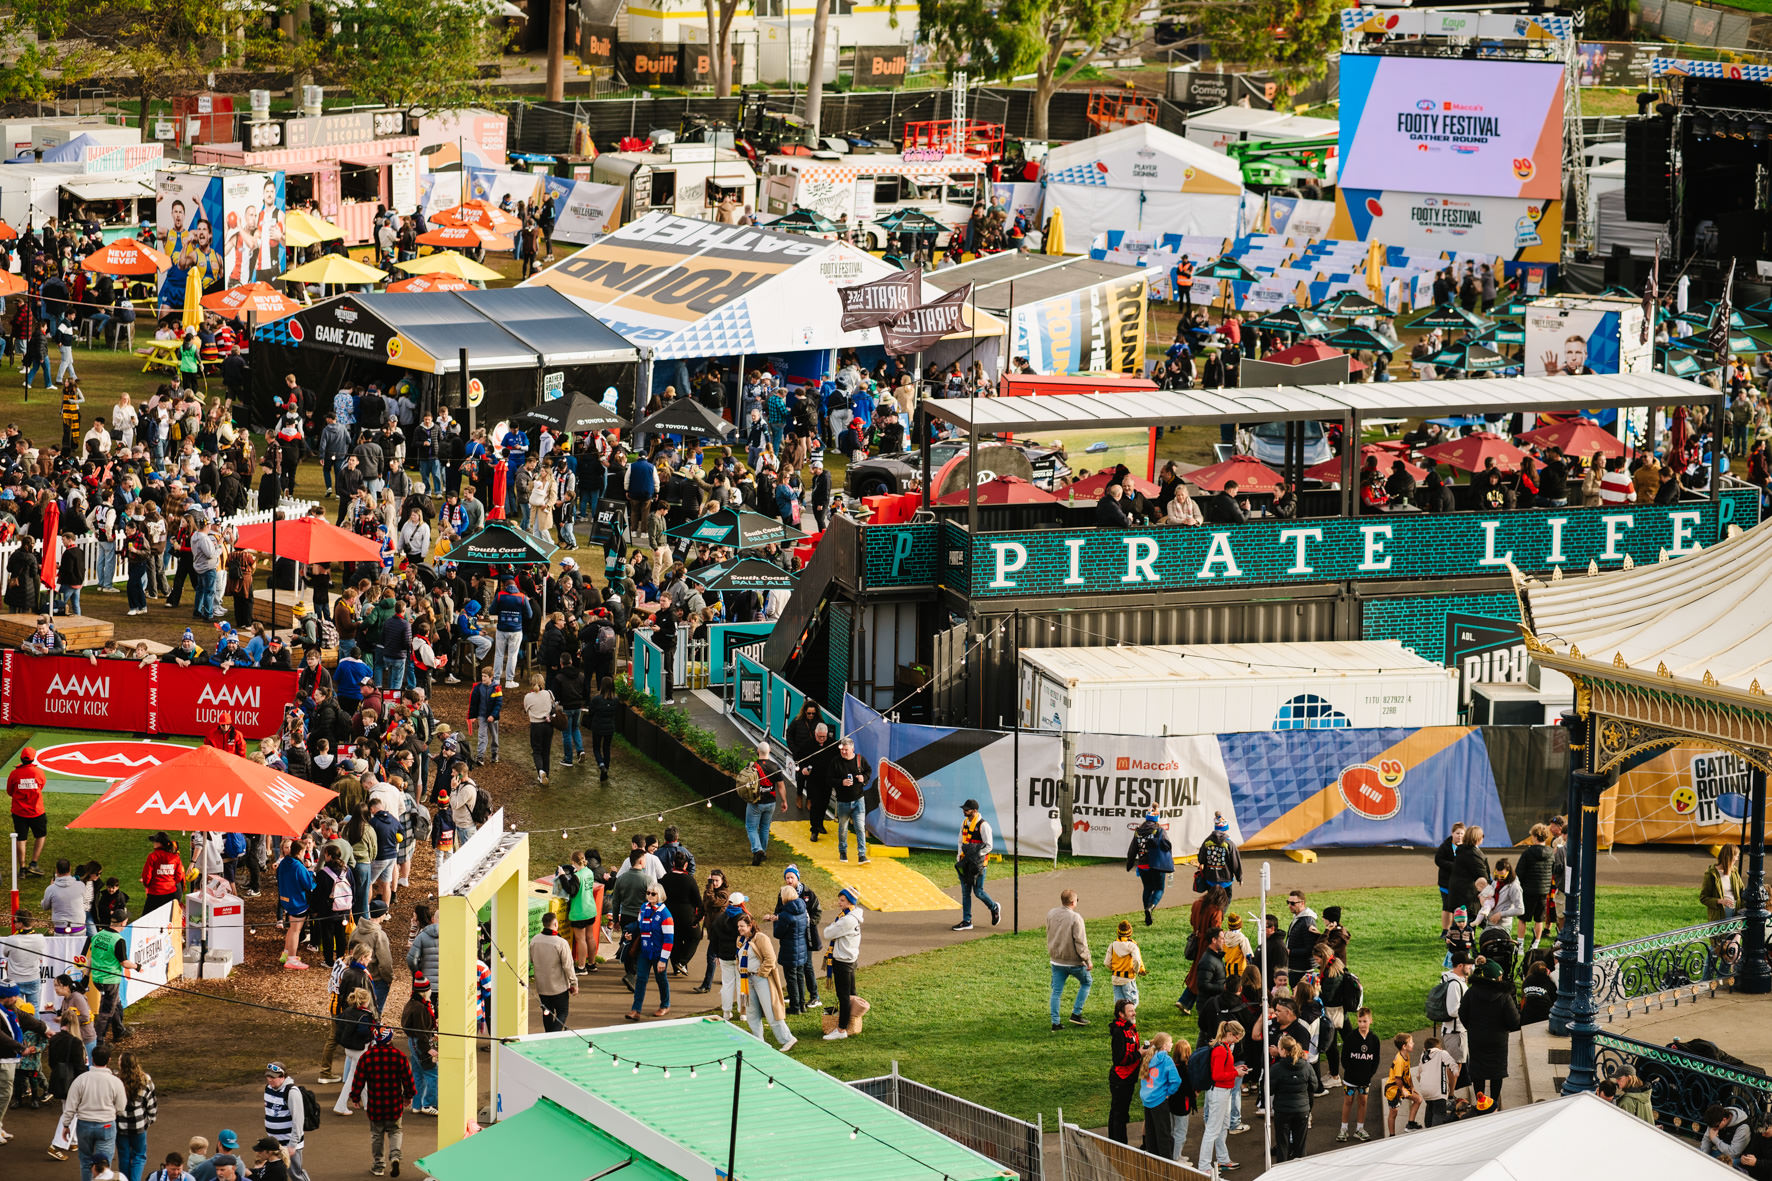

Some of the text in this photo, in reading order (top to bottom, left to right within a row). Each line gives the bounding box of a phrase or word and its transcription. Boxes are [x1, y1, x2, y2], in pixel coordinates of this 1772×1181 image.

[1442, 17, 1466, 31] Kayo
[590, 35, 612, 57] Built
[635, 54, 678, 74] Built
[872, 56, 907, 75] Built
[1191, 84, 1228, 98] Coming
[1453, 103, 1484, 112] Macca's
[1397, 113, 1501, 137] FOOTY FESTIVAL
[326, 128, 373, 143] RECORDS
[1409, 133, 1489, 144] GATHER ROUND
[1134, 164, 1158, 172] PLAYER
[1411, 207, 1482, 225] FOOTY FESTIVAL
[440, 232, 467, 240] NEVER
[444, 227, 470, 235] NEVER
[613, 211, 816, 256] GATHER
[106, 257, 138, 265] NEVER
[108, 249, 138, 258] NEVER
[838, 261, 863, 274] FESTIVAL
[437, 282, 467, 291] NEVER
[553, 256, 778, 315] ROUND
[253, 294, 282, 304] NEVER
[256, 301, 286, 312] NEVER
[315, 324, 375, 350] GAME ZONE
[1044, 297, 1073, 377] ROUN
[1089, 286, 1107, 372] GATHE
[545, 373, 563, 384] GATHER
[744, 525, 784, 538] South Coast
[747, 533, 769, 543] PALE
[467, 551, 500, 559] PALE
[468, 545, 498, 553] South
[988, 511, 1702, 588] PIRATE LIFE
[4, 652, 12, 673] AAMI
[150, 663, 158, 683] AAMI
[1463, 643, 1528, 706] PIRA
[3, 677, 11, 697] AAMI
[46, 672, 110, 699] AAMI
[149, 687, 157, 707] AAMI
[196, 682, 261, 709] AAMI
[1365, 695, 1380, 705] TITU
[1382, 694, 1404, 705] 827922
[2, 701, 10, 721] AAMI
[45, 697, 109, 717] LUCKY KICK
[234, 709, 260, 727] KICK
[1075, 755, 1101, 768] AFL
[1131, 759, 1180, 771] Macca's
[1694, 753, 1749, 779] GATHE
[263, 775, 306, 815] AAMI
[1114, 776, 1201, 808] FESTIVAL
[1696, 773, 1752, 801] ROUND
[135, 790, 244, 817] AAMI
[1048, 805, 1127, 819] GATHER
[1699, 799, 1720, 822] IT!
[1350, 1051, 1374, 1061] MIAM
